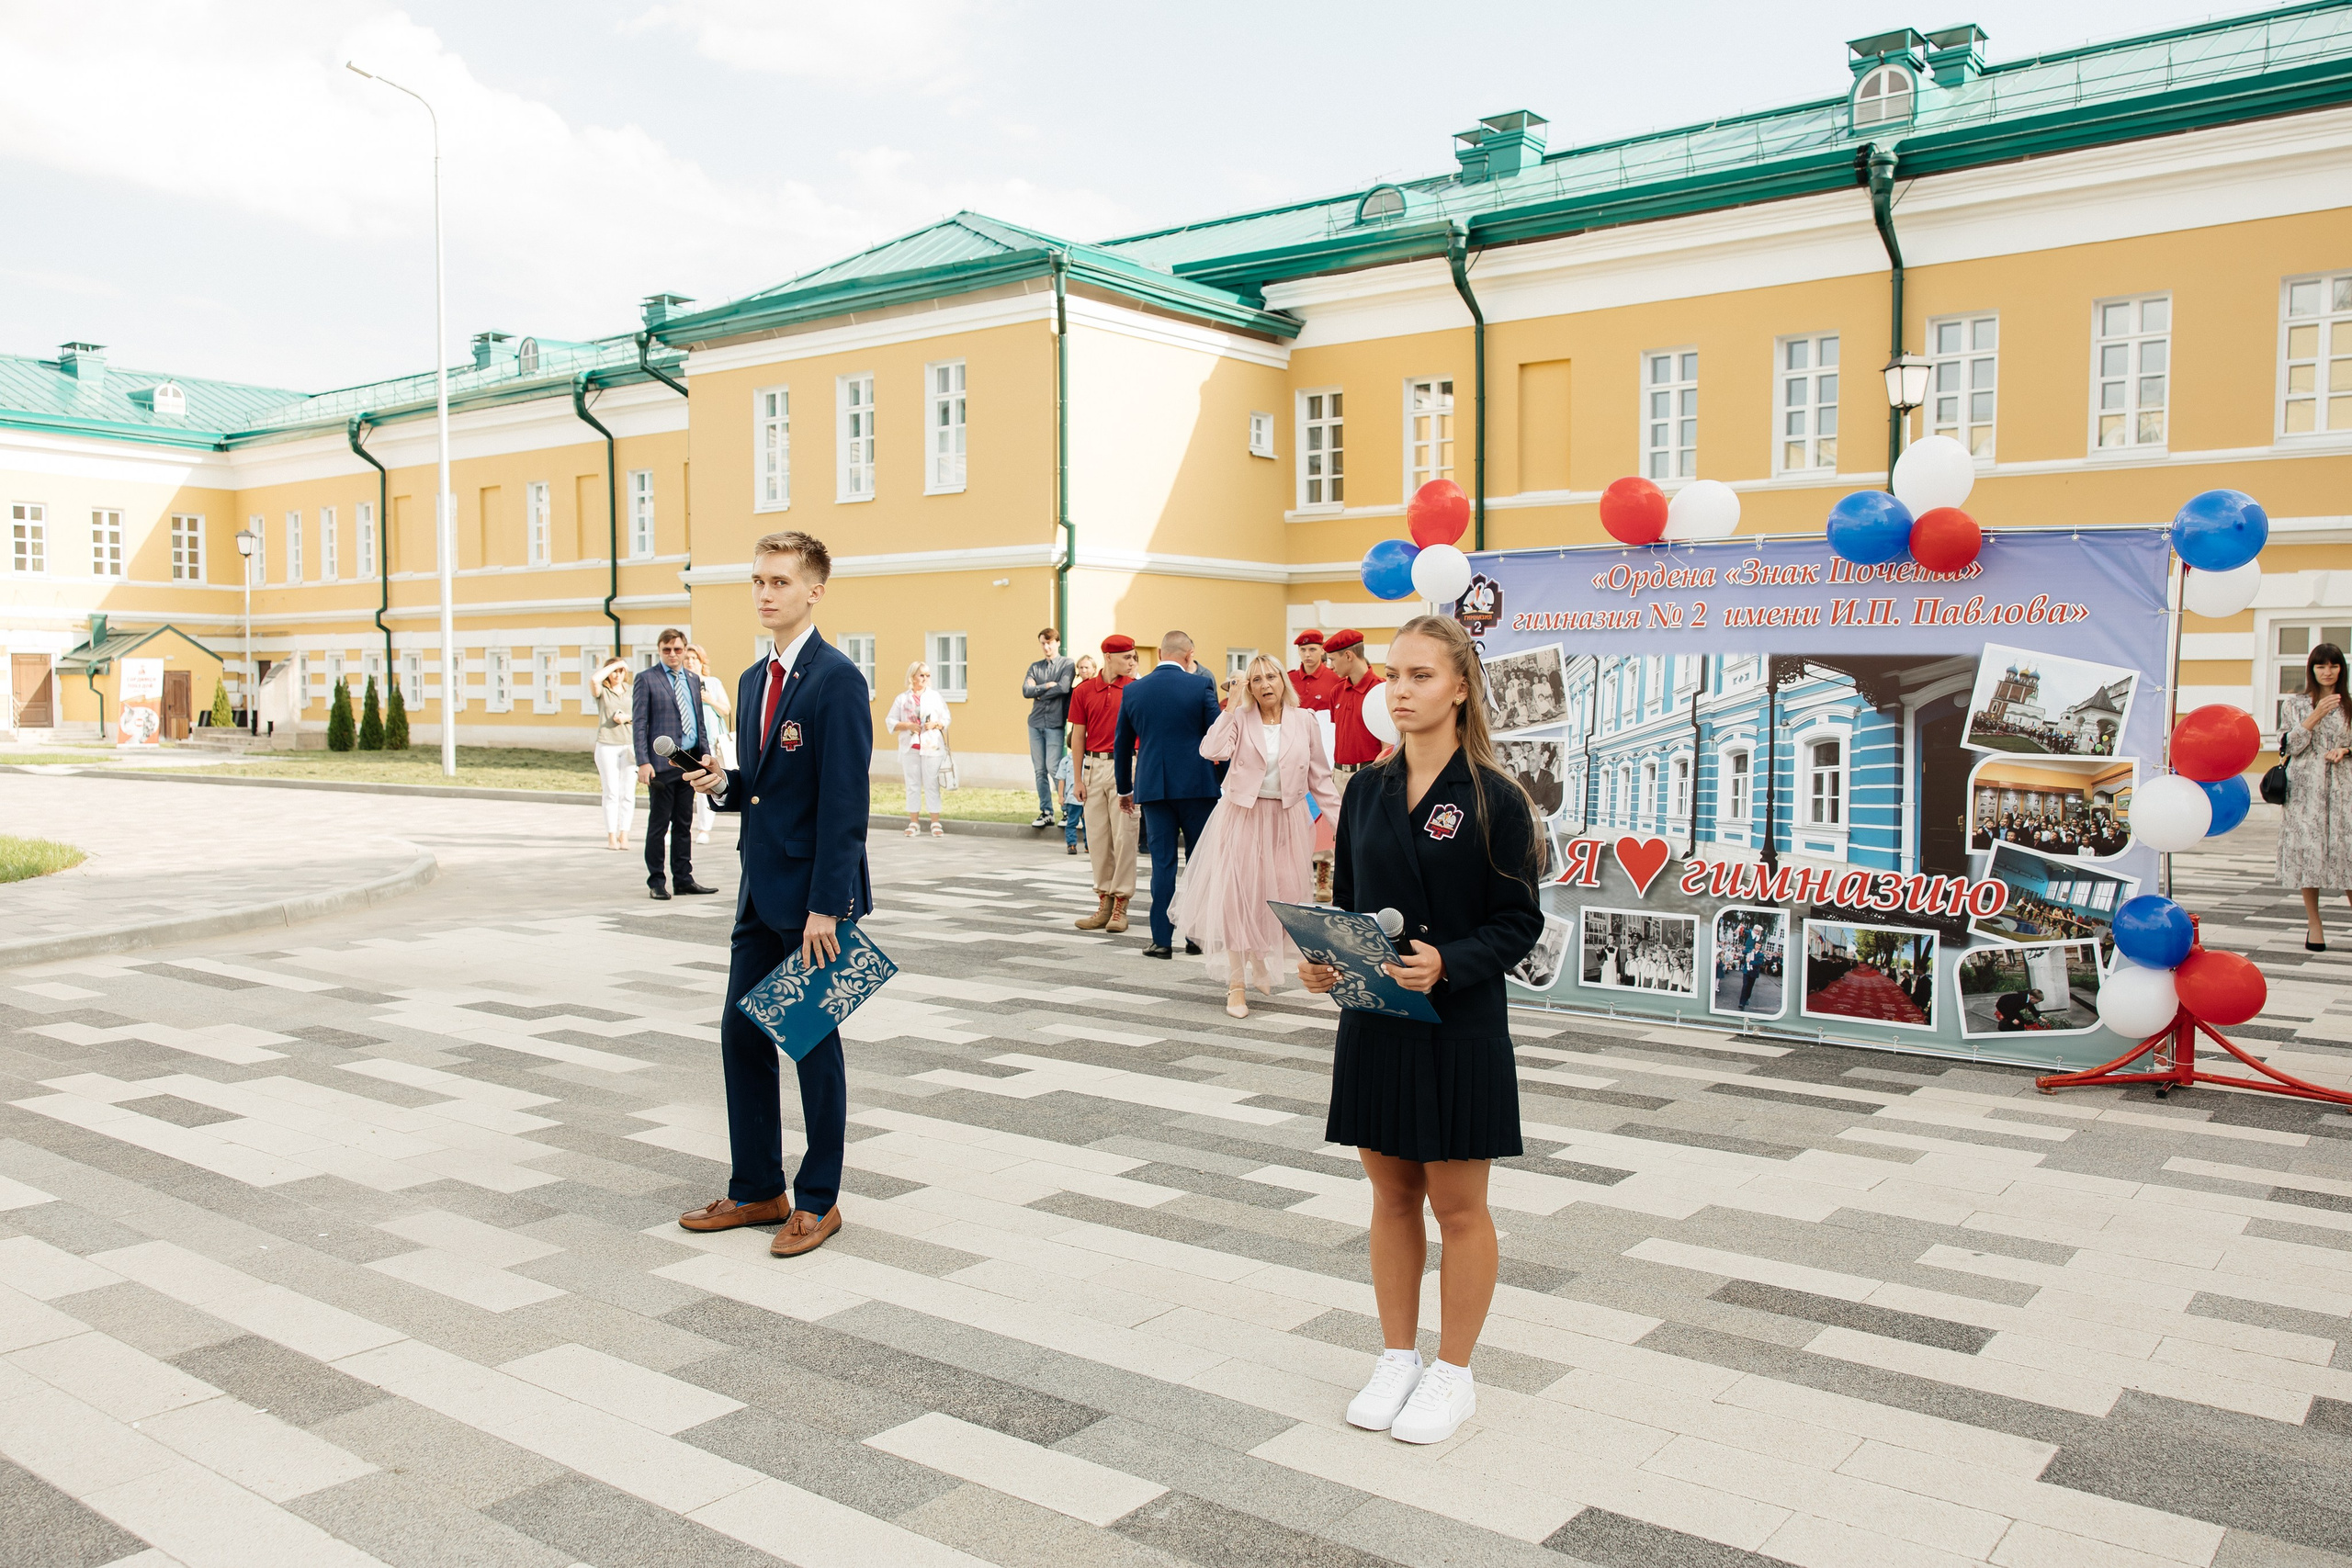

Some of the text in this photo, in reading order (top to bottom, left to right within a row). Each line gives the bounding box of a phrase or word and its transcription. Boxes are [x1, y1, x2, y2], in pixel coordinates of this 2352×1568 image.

[1591, 561, 1716, 598] «Ордена
[1724, 558, 1821, 586] «Знак
[1474, 621, 1482, 633] 2
[1512, 593, 2090, 631] гимназия № 2 имени И.П. Павлова»
[1555, 838, 1606, 887] Я
[1679, 859, 2009, 918] гимназию
